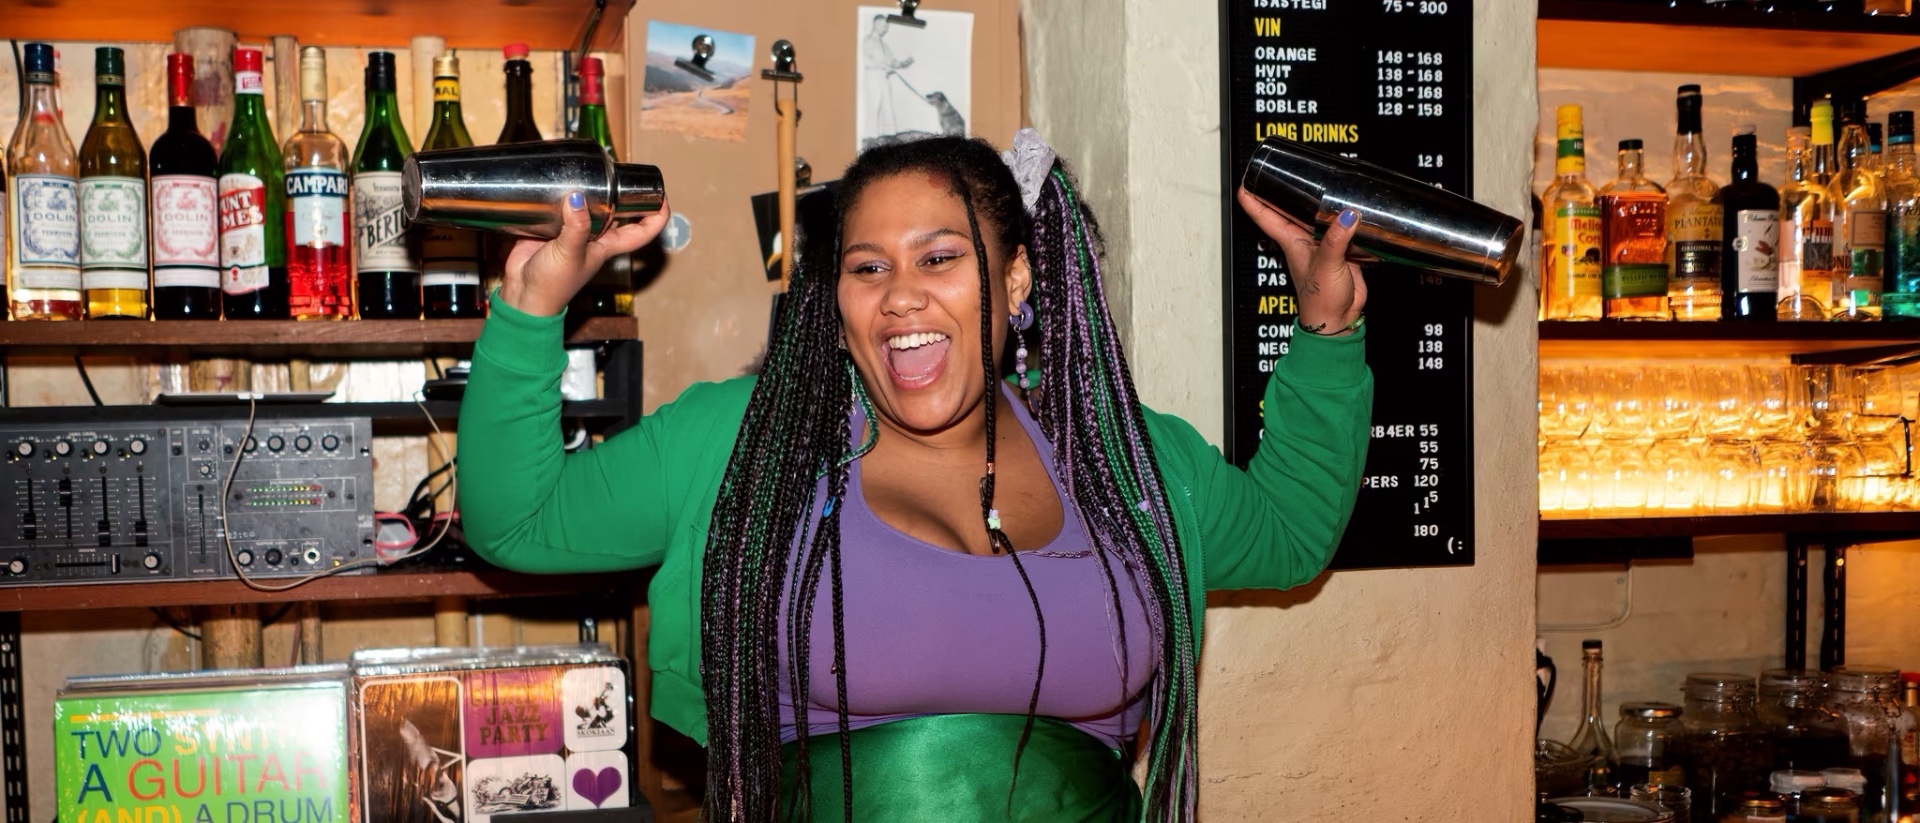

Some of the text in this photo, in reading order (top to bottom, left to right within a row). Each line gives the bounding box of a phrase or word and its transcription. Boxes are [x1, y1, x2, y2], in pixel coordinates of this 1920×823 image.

[1383, 0, 1403, 13] 75
[1420, 1, 1448, 15] 300
[1254, 17, 1281, 37] VIN
[1255, 46, 1317, 61] ORANGE
[1378, 50, 1403, 64] 148
[1418, 51, 1443, 65] 168
[1255, 64, 1291, 78] HVIT
[1378, 67, 1403, 81] 138
[1418, 68, 1443, 82] 168
[1255, 78, 1287, 95] RÖD
[1378, 84, 1403, 98] 138
[1418, 86, 1443, 99] 168
[1255, 98, 1318, 114] BOBLER
[1378, 102, 1403, 116] 128
[1418, 103, 1443, 117] 158
[1256, 122, 1359, 143] LONG DRINKS
[287, 176, 348, 195] CAMPARI
[33, 212, 76, 223] DOLIN
[88, 213, 131, 223] DOLIN
[164, 212, 208, 223] DOLIN
[1258, 273, 1287, 287] PAS
[1424, 324, 1443, 336] 98
[1258, 341, 1443, 356] NEG 138
[1258, 358, 1443, 373] GI 148
[1419, 424, 1439, 437] 55
[1419, 441, 1439, 454] 55
[1419, 458, 1439, 471] 75
[1414, 475, 1439, 488] 120
[1414, 525, 1439, 537] 180
[485, 703, 542, 725] JAZZ
[479, 723, 549, 746] PARTY
[577, 727, 616, 736] SKOKIAAN
[71, 727, 162, 760] TWO
[77, 751, 328, 805] A GUITAR
[226, 797, 333, 823] DRUM
